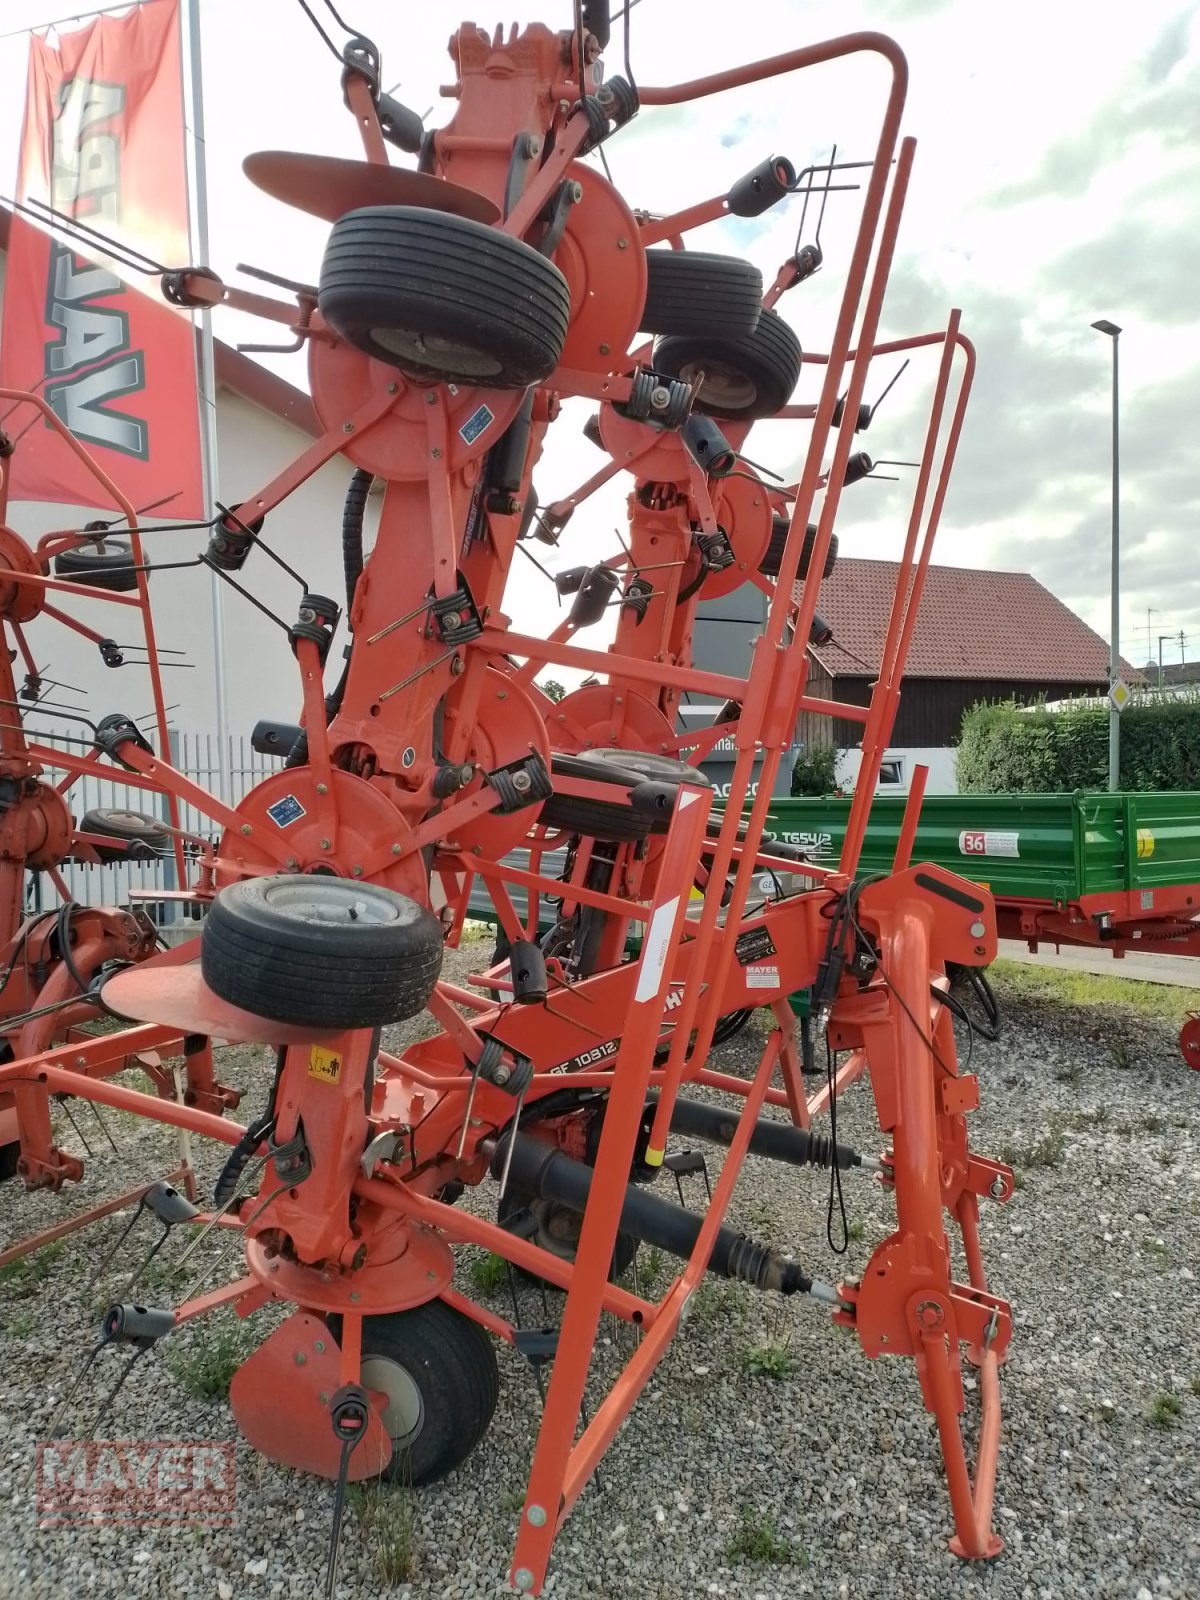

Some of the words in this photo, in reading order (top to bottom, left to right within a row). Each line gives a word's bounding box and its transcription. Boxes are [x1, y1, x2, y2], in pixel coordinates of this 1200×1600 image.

[966, 835, 984, 851] 36
[746, 966, 778, 974] MAYER
[575, 1041, 617, 1067] 10812
